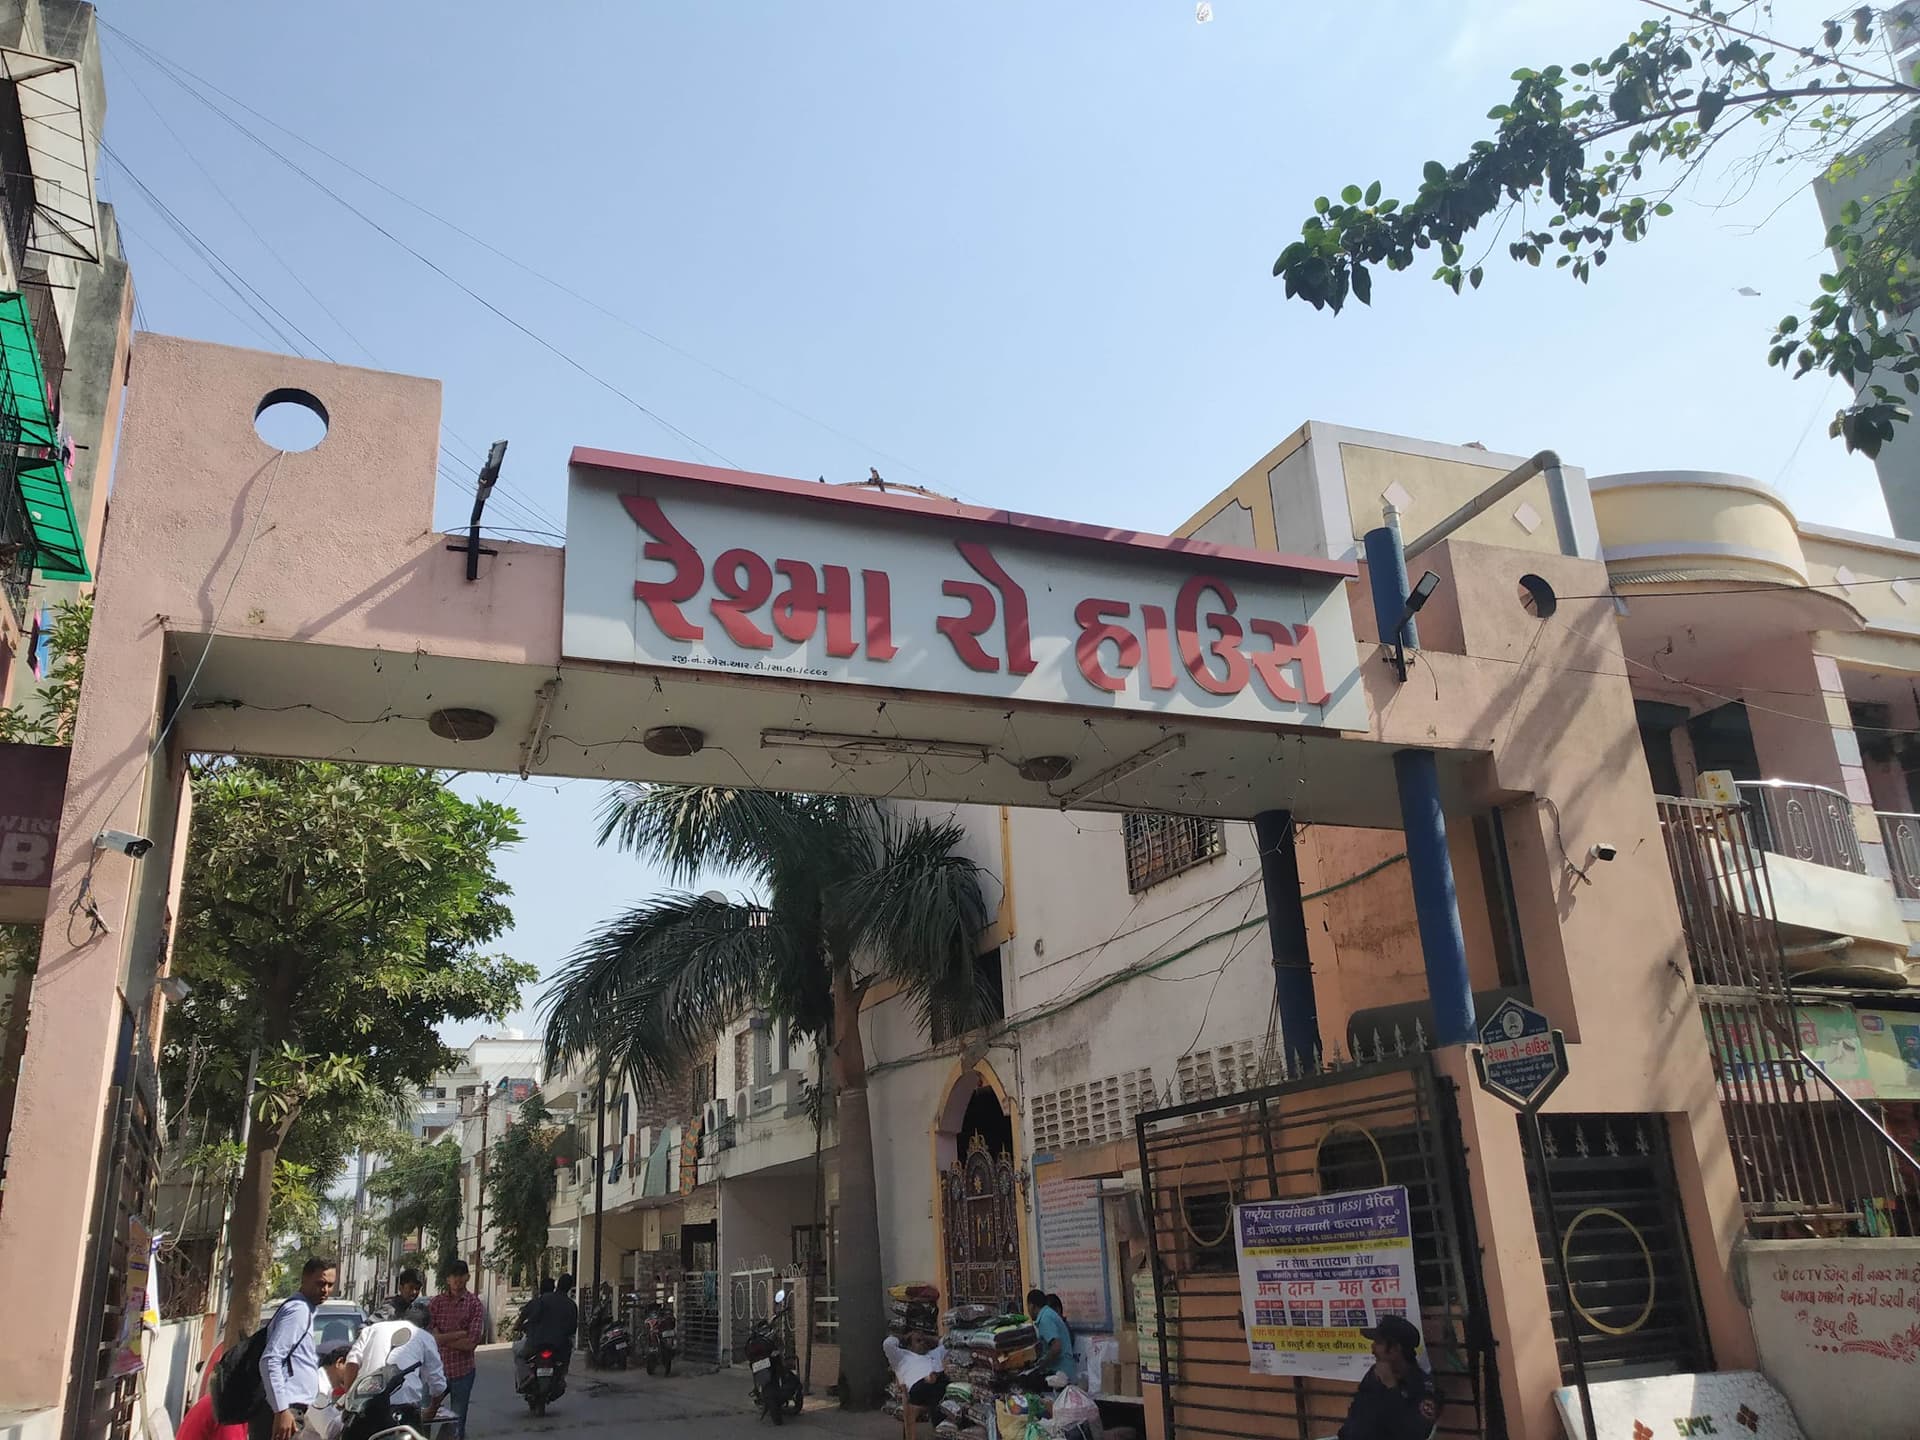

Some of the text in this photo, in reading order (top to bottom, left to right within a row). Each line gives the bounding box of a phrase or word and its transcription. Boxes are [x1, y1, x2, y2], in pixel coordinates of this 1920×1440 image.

[937, 541, 1039, 675] રો
[1075, 575, 1332, 706] હાઉસ
[0, 832, 49, 879] B
[1257, 1282, 1282, 1296] अन्न
[1287, 1281, 1315, 1297] दान
[1338, 1280, 1364, 1296] महा
[1369, 1278, 1400, 1296] दान
[1673, 1414, 1718, 1437] SMC
